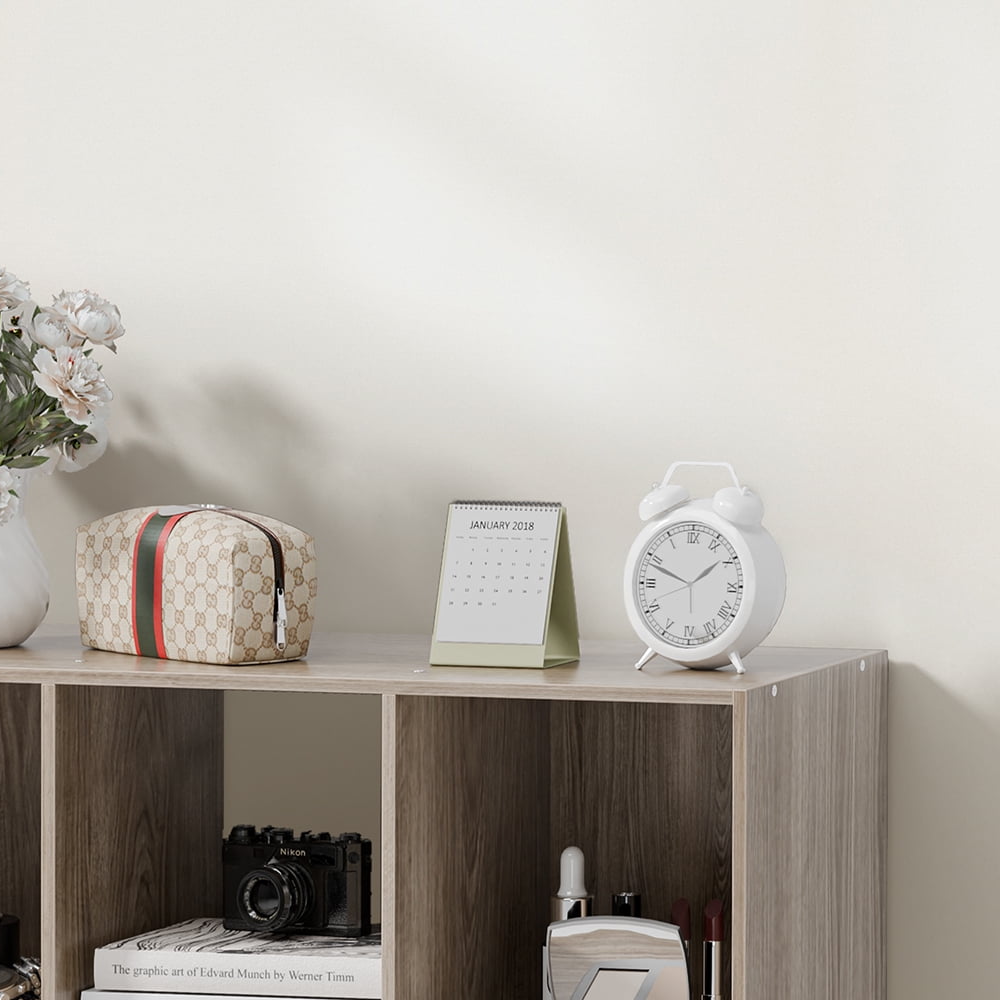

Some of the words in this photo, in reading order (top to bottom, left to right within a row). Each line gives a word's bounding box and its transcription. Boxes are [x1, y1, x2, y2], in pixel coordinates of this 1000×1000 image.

[470, 521, 511, 530] JANUARY
[512, 521, 535, 531] 2018
[280, 848, 306, 857] Nikon
[111, 964, 130, 975] The
[133, 965, 168, 978] graphic
[171, 967, 184, 977] art
[187, 966, 199, 977] of
[200, 967, 234, 978] Edvard
[237, 968, 271, 979] Munch
[274, 969, 285, 983] by
[288, 970, 323, 981] Werner
[325, 971, 355, 983] Timm
